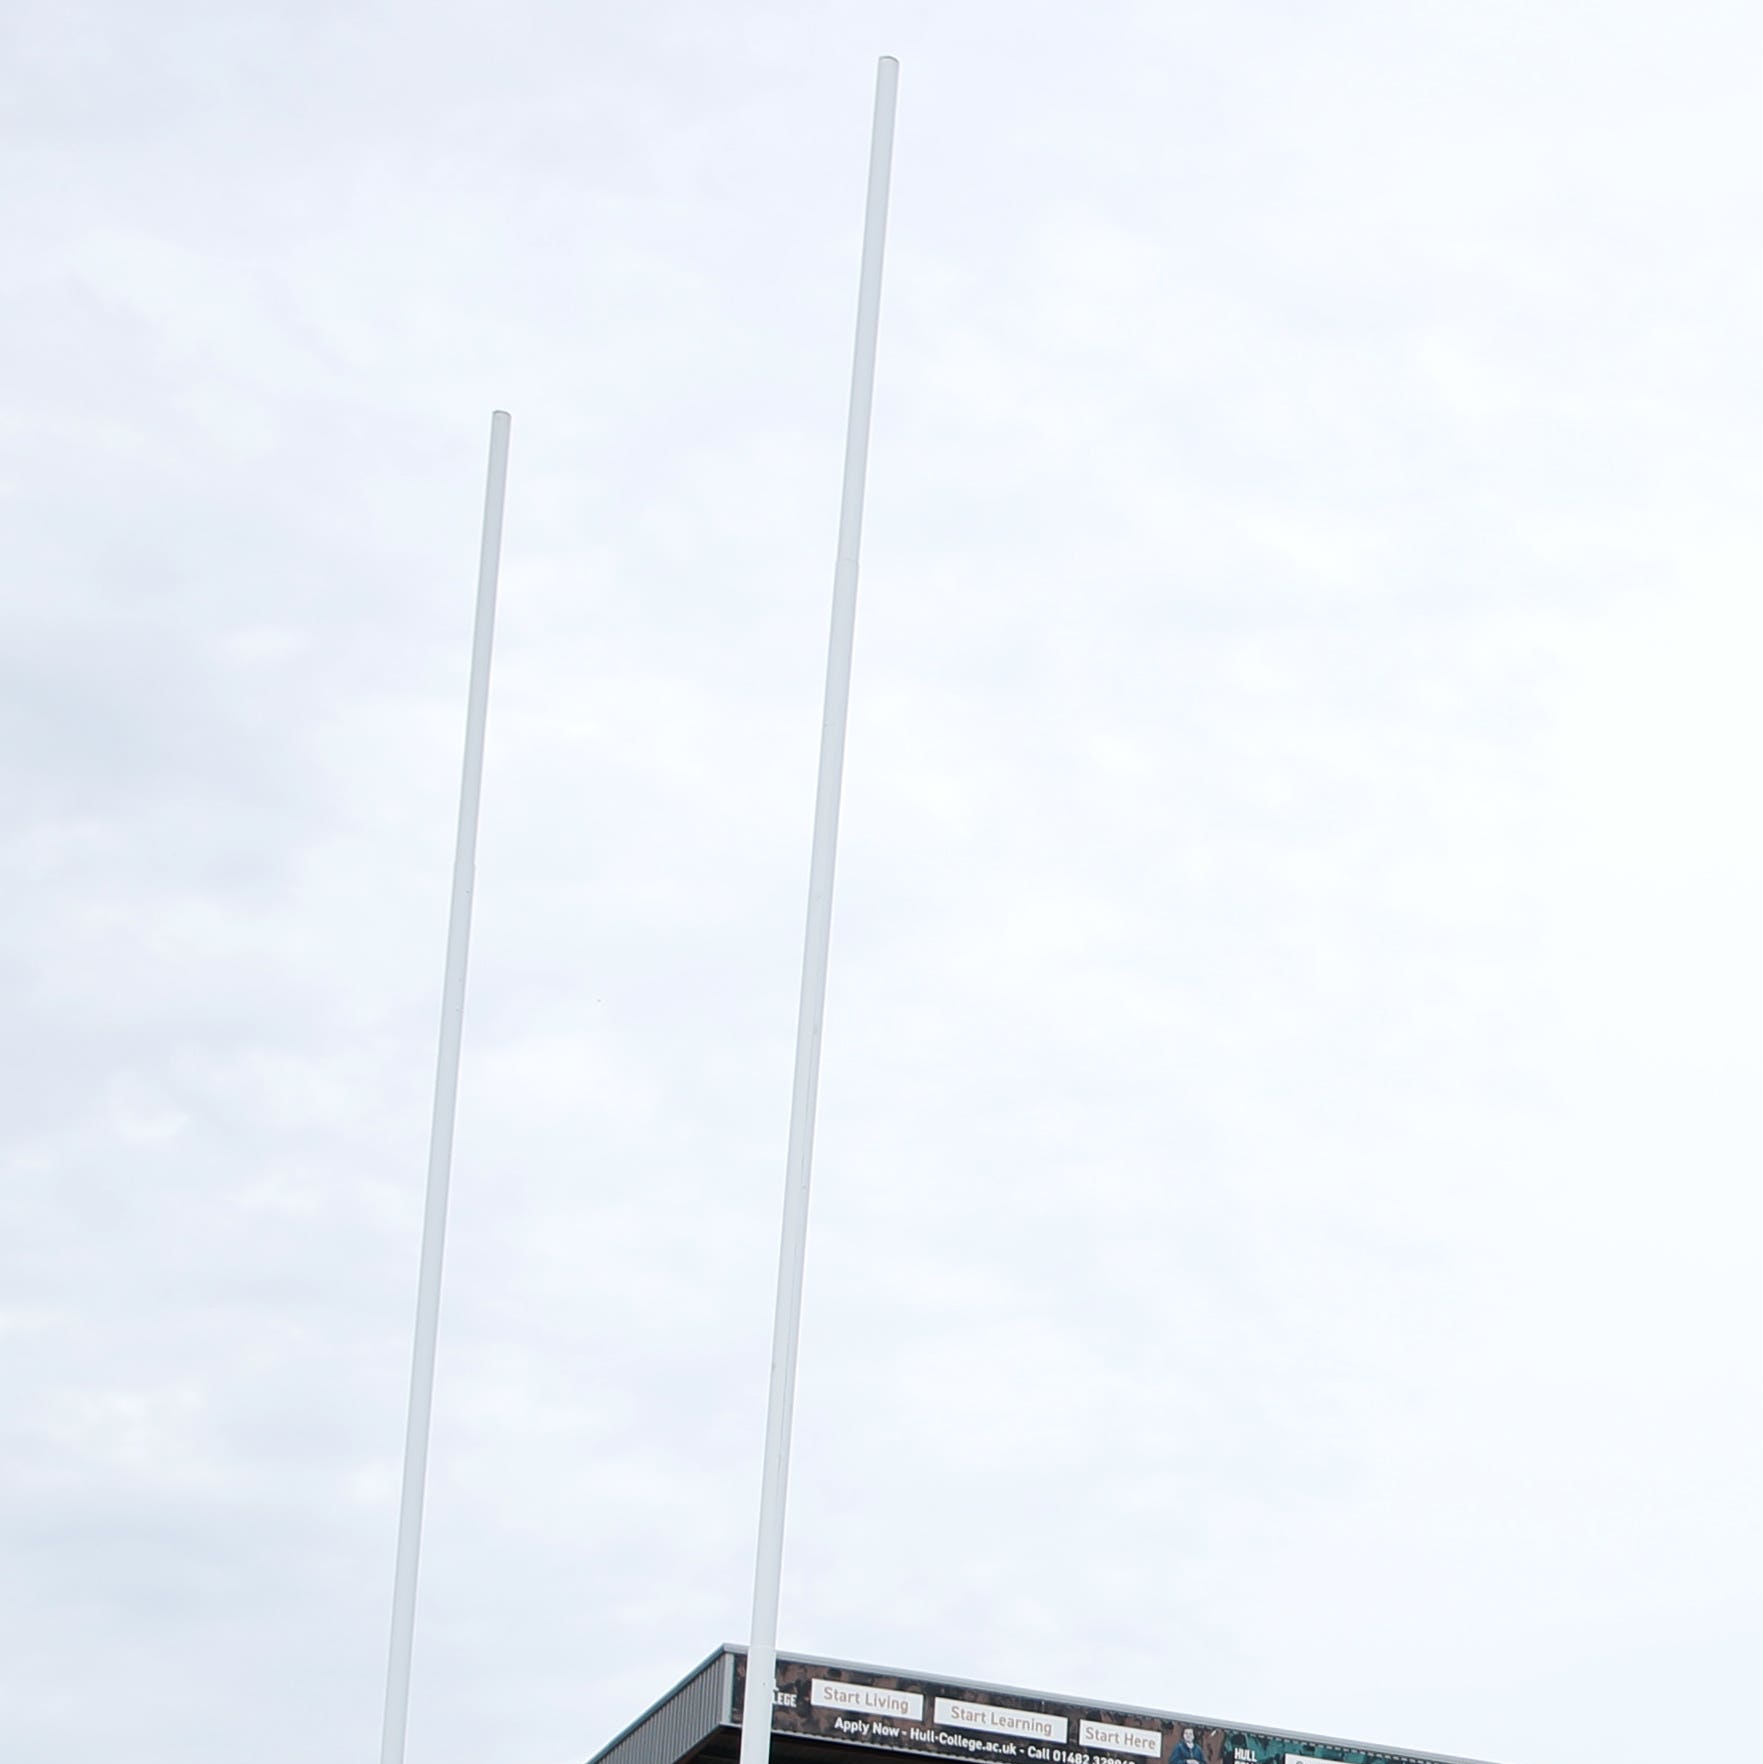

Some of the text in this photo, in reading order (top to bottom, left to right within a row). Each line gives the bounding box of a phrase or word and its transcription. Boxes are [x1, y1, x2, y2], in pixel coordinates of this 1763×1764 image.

[823, 1686, 910, 1715] Start Living
[950, 1706, 1053, 1737] Start Learning
[834, 1717, 869, 1736] Apply
[872, 1723, 900, 1737] Now
[1027, 1745, 1050, 1760] Call
[1084, 1726, 1157, 1750] Start Here
[1234, 1747, 1258, 1763] HULL
